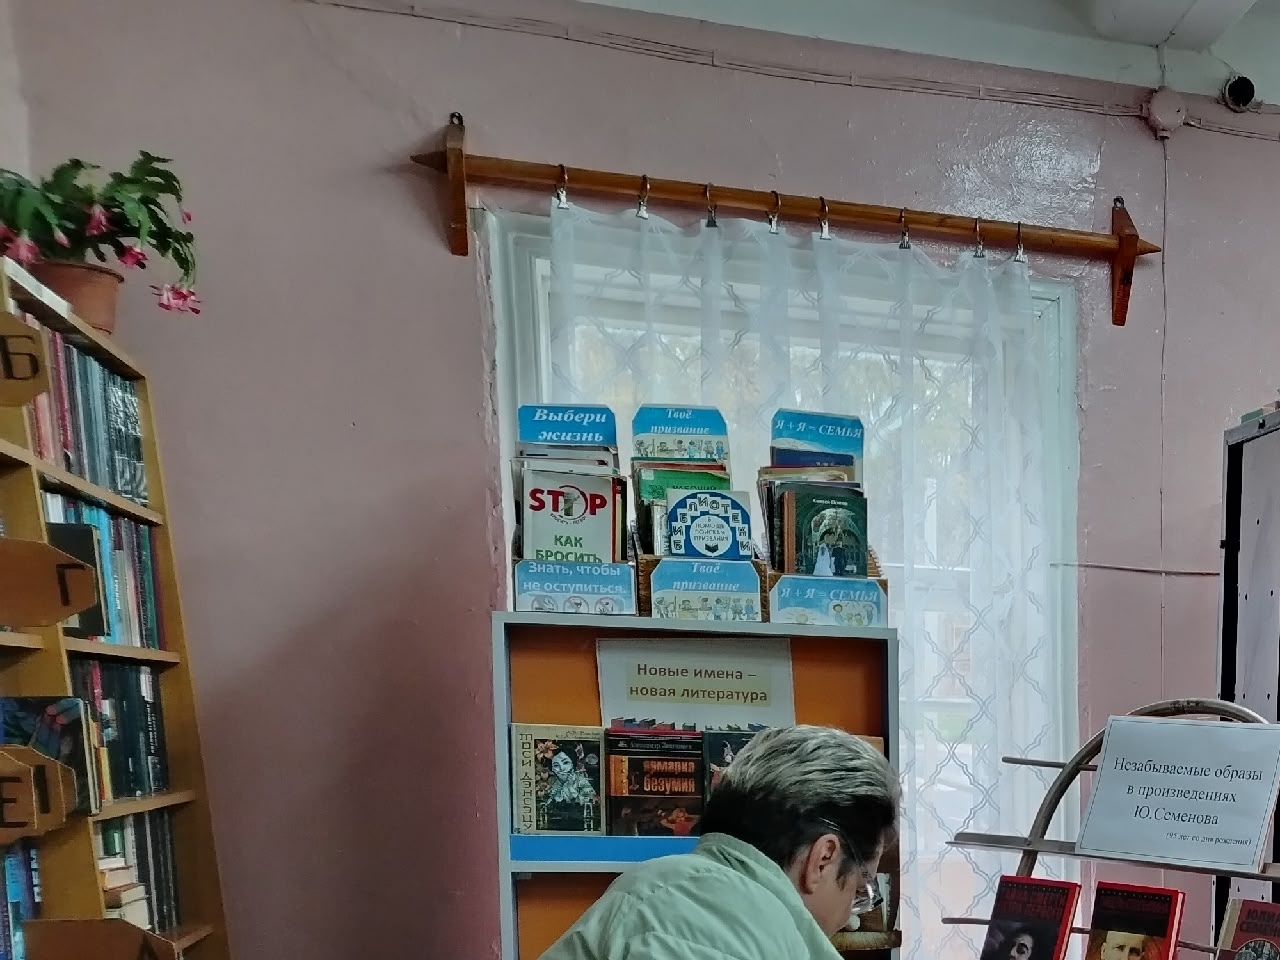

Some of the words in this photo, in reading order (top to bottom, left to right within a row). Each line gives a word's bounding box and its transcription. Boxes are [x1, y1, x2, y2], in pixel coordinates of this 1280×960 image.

[1, 333, 38, 382] Б
[533, 407, 607, 426] Выбери
[666, 407, 692, 421] Твоё
[537, 427, 605, 444] жизнь
[650, 422, 710, 437] призвание
[775, 418, 786, 432] Я
[796, 420, 808, 433] Я
[818, 421, 863, 440] СЕМЬЯ
[529, 485, 607, 520] STOP
[553, 535, 584, 549] КАК
[528, 562, 573, 576] Знать,
[576, 564, 621, 576] чтобы
[691, 562, 720, 574] Твоё
[55, 562, 87, 607] Г
[523, 582, 541, 591] не
[543, 582, 626, 594] оступиться.
[672, 577, 741, 592] призвание
[828, 588, 879, 602] СЕМЬЯ
[637, 663, 689, 680] Новые
[694, 667, 744, 681] имена
[629, 684, 677, 698] новая
[681, 686, 768, 703] литература
[1113, 757, 1211, 778] Незабываемые
[1214, 764, 1263, 783] образы
[643, 774, 695, 794] безумия
[1126, 784, 1135, 796] в
[1138, 786, 1238, 804] произведениях
[1133, 804, 1220, 826] Ю.Семенова
